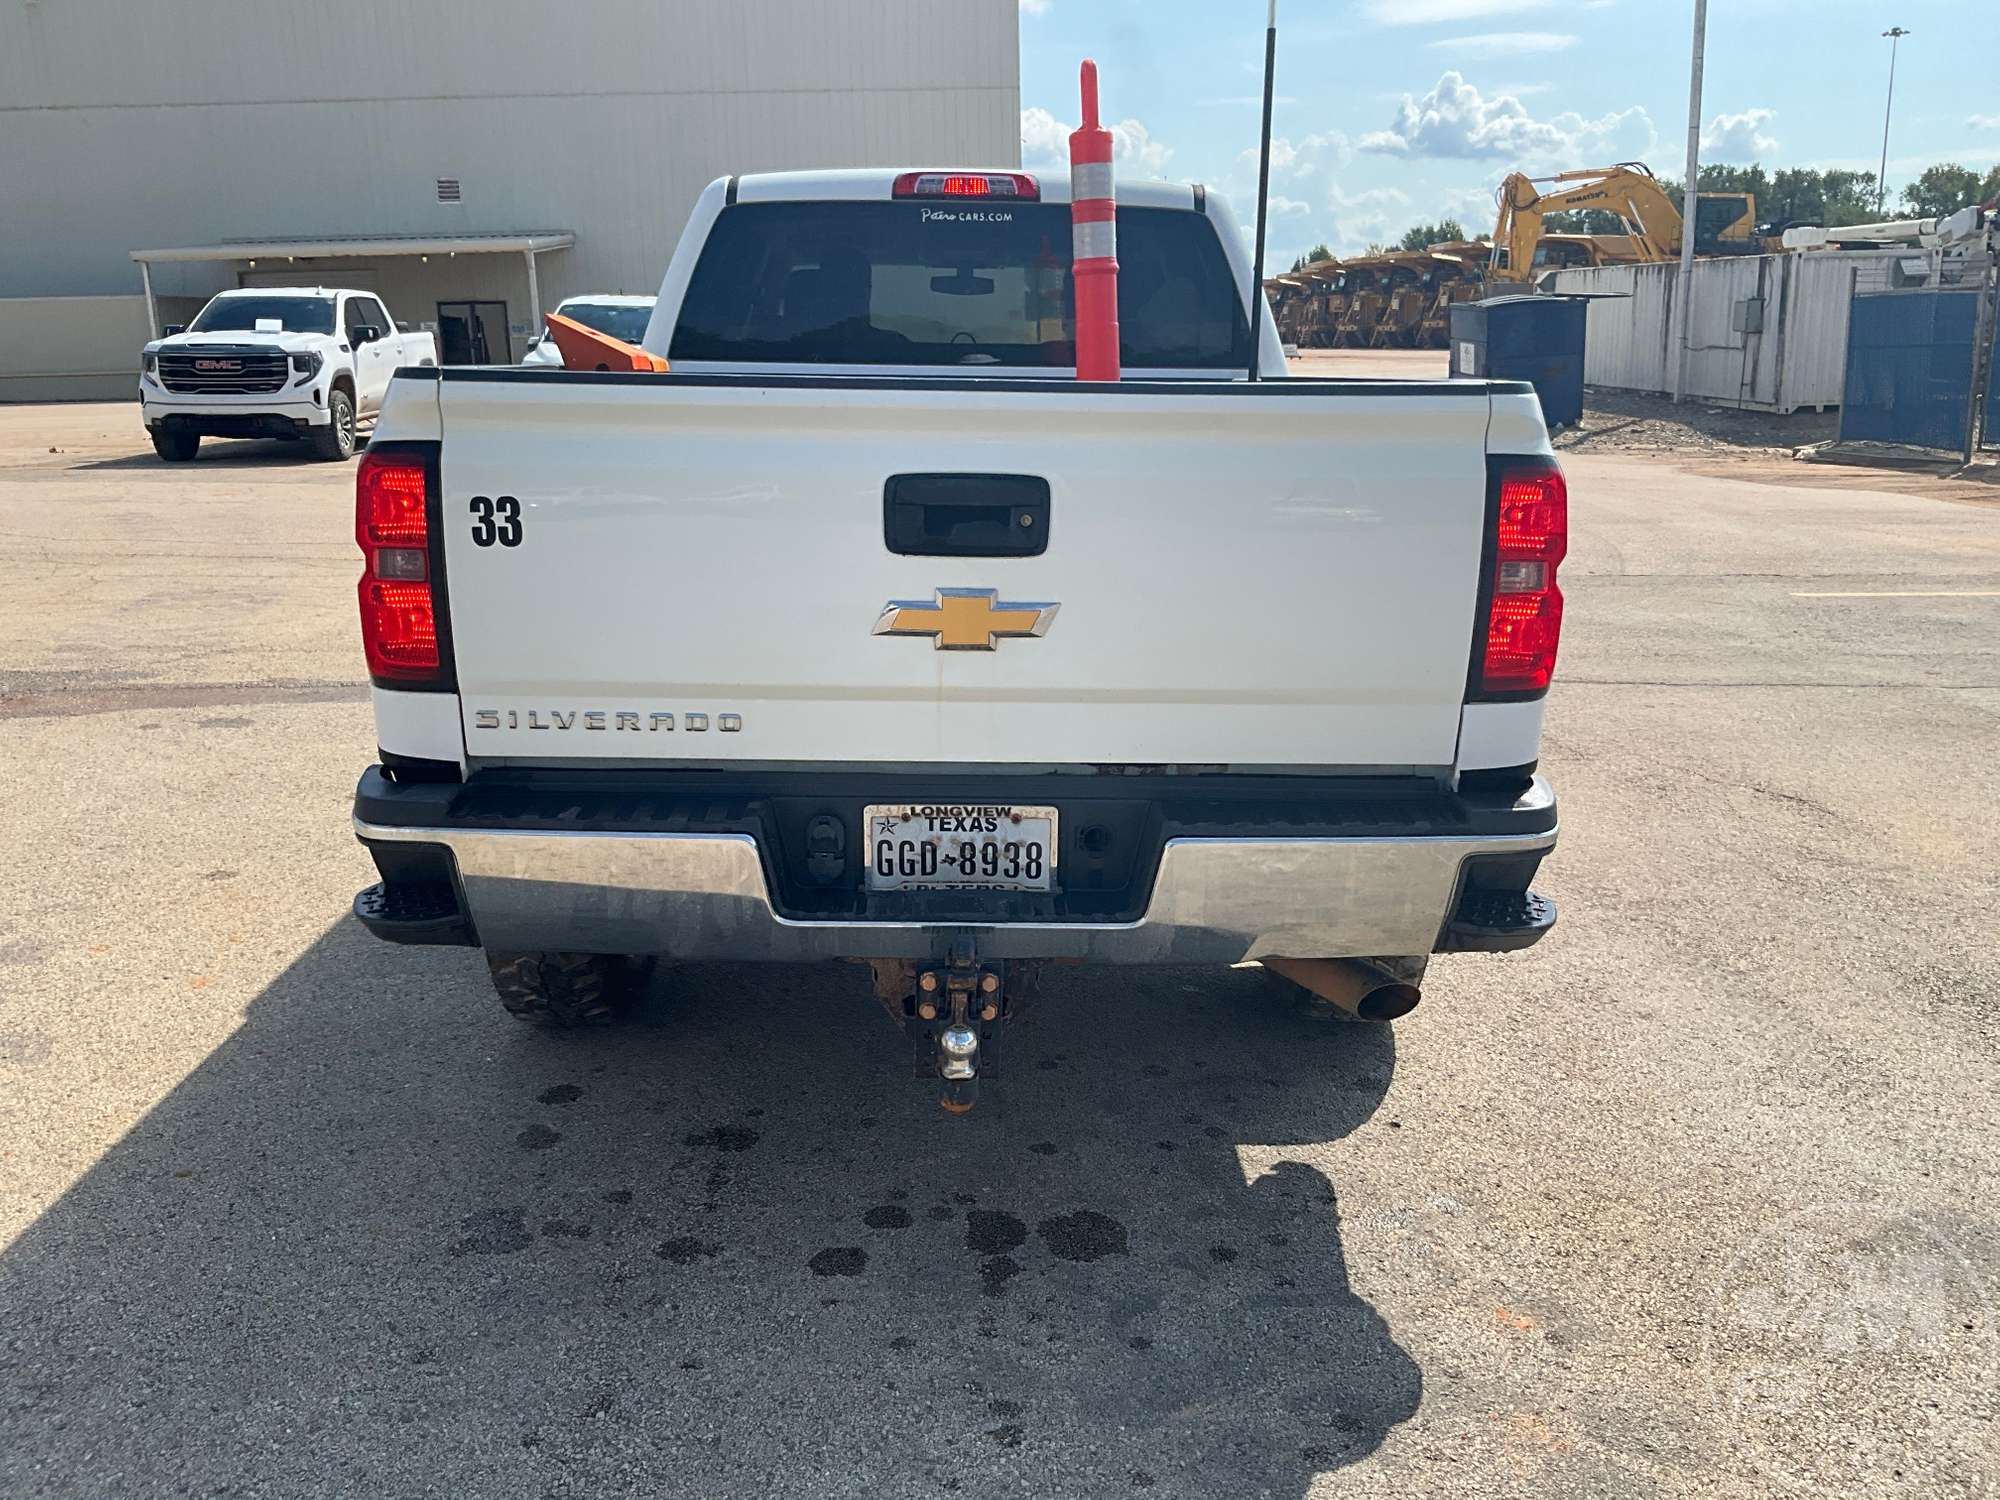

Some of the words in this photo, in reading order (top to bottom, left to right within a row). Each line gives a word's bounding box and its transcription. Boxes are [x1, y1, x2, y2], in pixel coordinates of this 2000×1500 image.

[195, 360, 242, 369] GMC
[469, 496, 523, 547] 33
[476, 709, 742, 732] SILVERADO
[910, 806, 1012, 817] LONGVIEW
[924, 816, 998, 832] TEXAS
